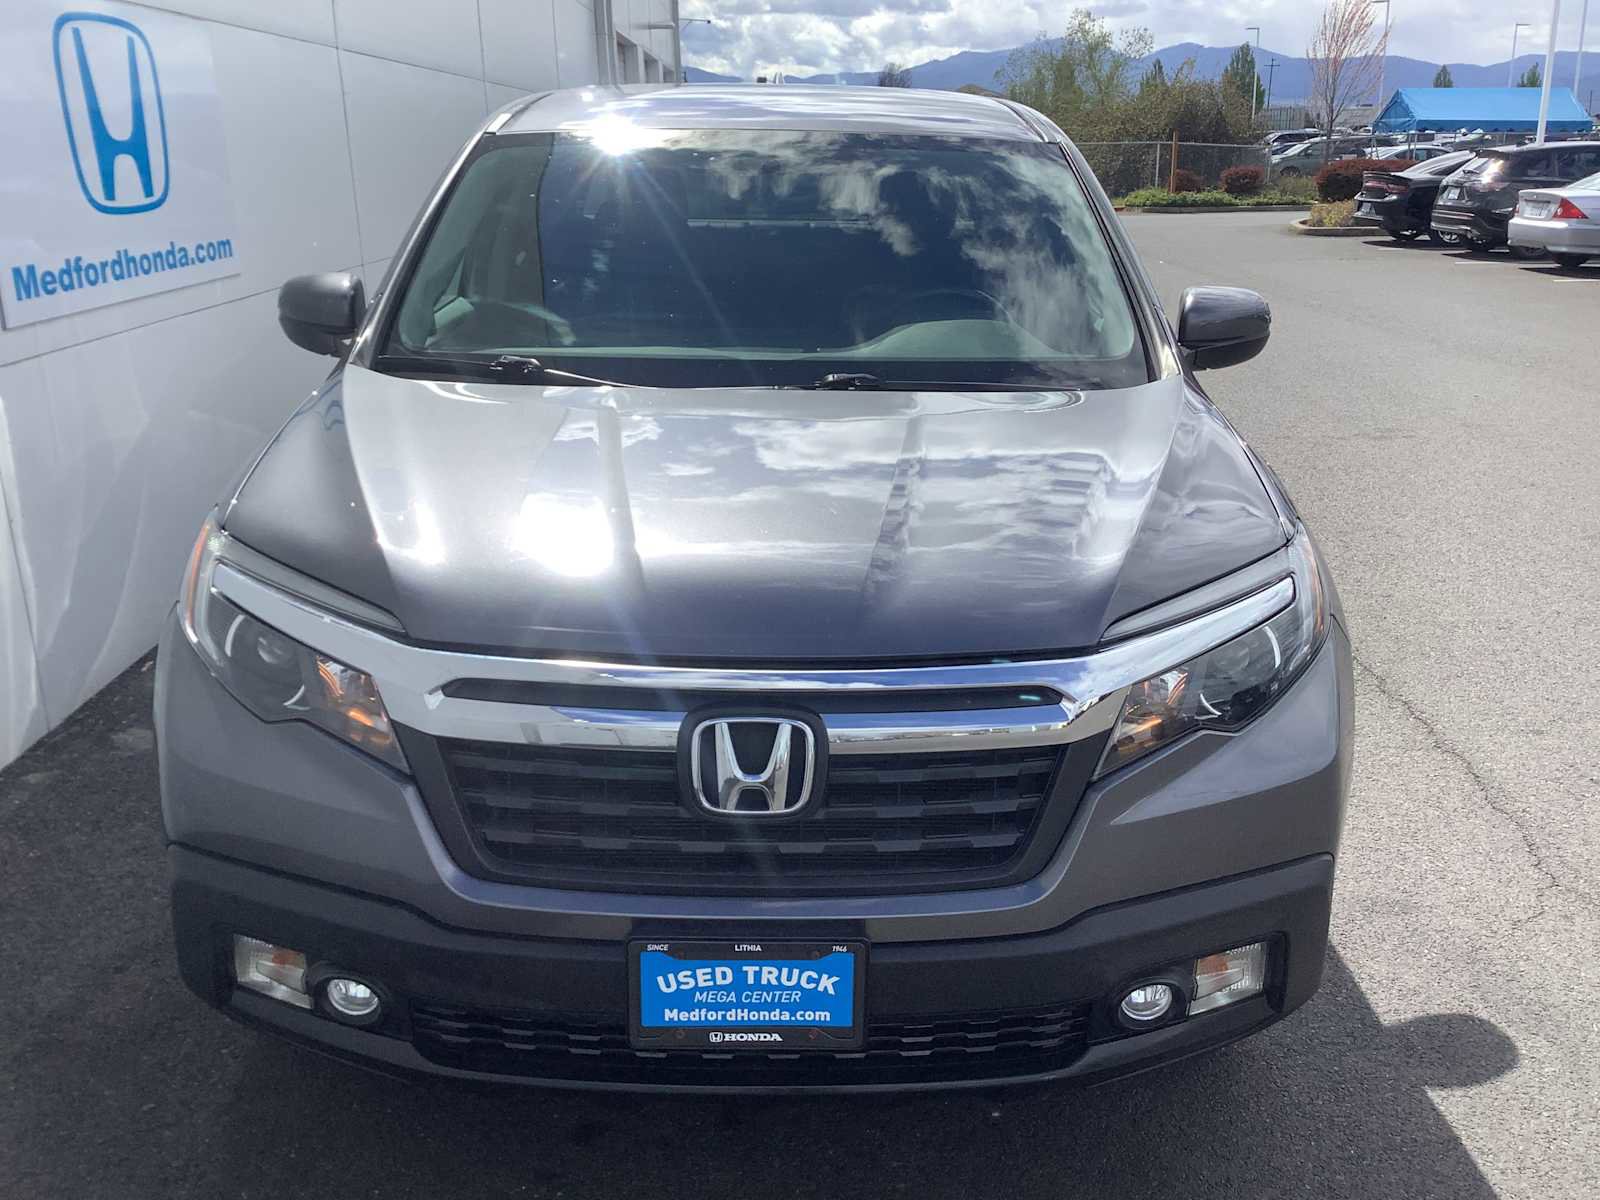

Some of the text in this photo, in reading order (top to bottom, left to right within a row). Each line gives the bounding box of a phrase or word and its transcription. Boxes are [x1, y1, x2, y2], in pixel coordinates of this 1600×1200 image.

[11, 238, 233, 301] Medfordhonda.com
[647, 943, 669, 951] SINCE
[734, 944, 762, 952] LITHIA
[656, 965, 841, 995] USED TRUCK
[694, 991, 802, 1003] MEGA CENTER
[664, 1008, 831, 1022] MedfordHonda.com
[724, 1032, 783, 1042] HONDA
